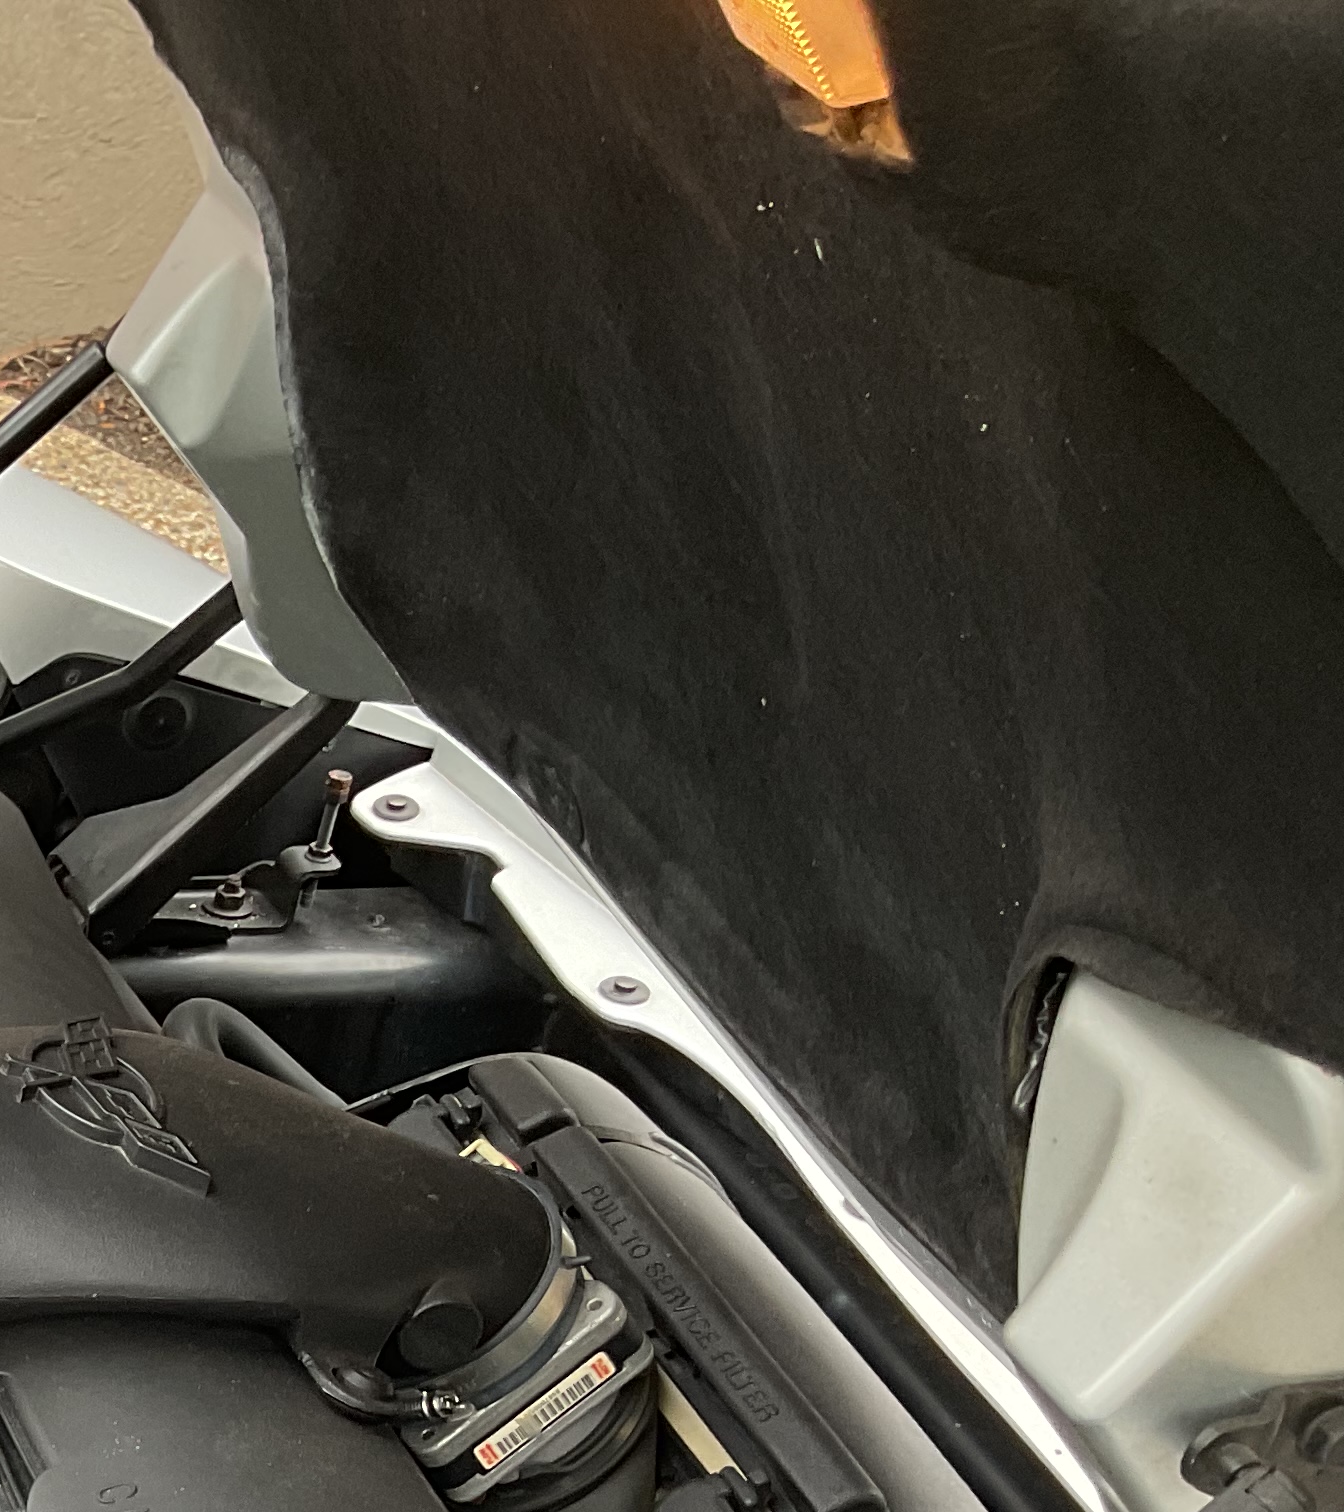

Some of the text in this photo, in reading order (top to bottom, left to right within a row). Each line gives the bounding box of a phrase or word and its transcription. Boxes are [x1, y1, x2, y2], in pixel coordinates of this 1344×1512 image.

[581, 1185, 780, 1423] PULL TO SERVICE FILTER
